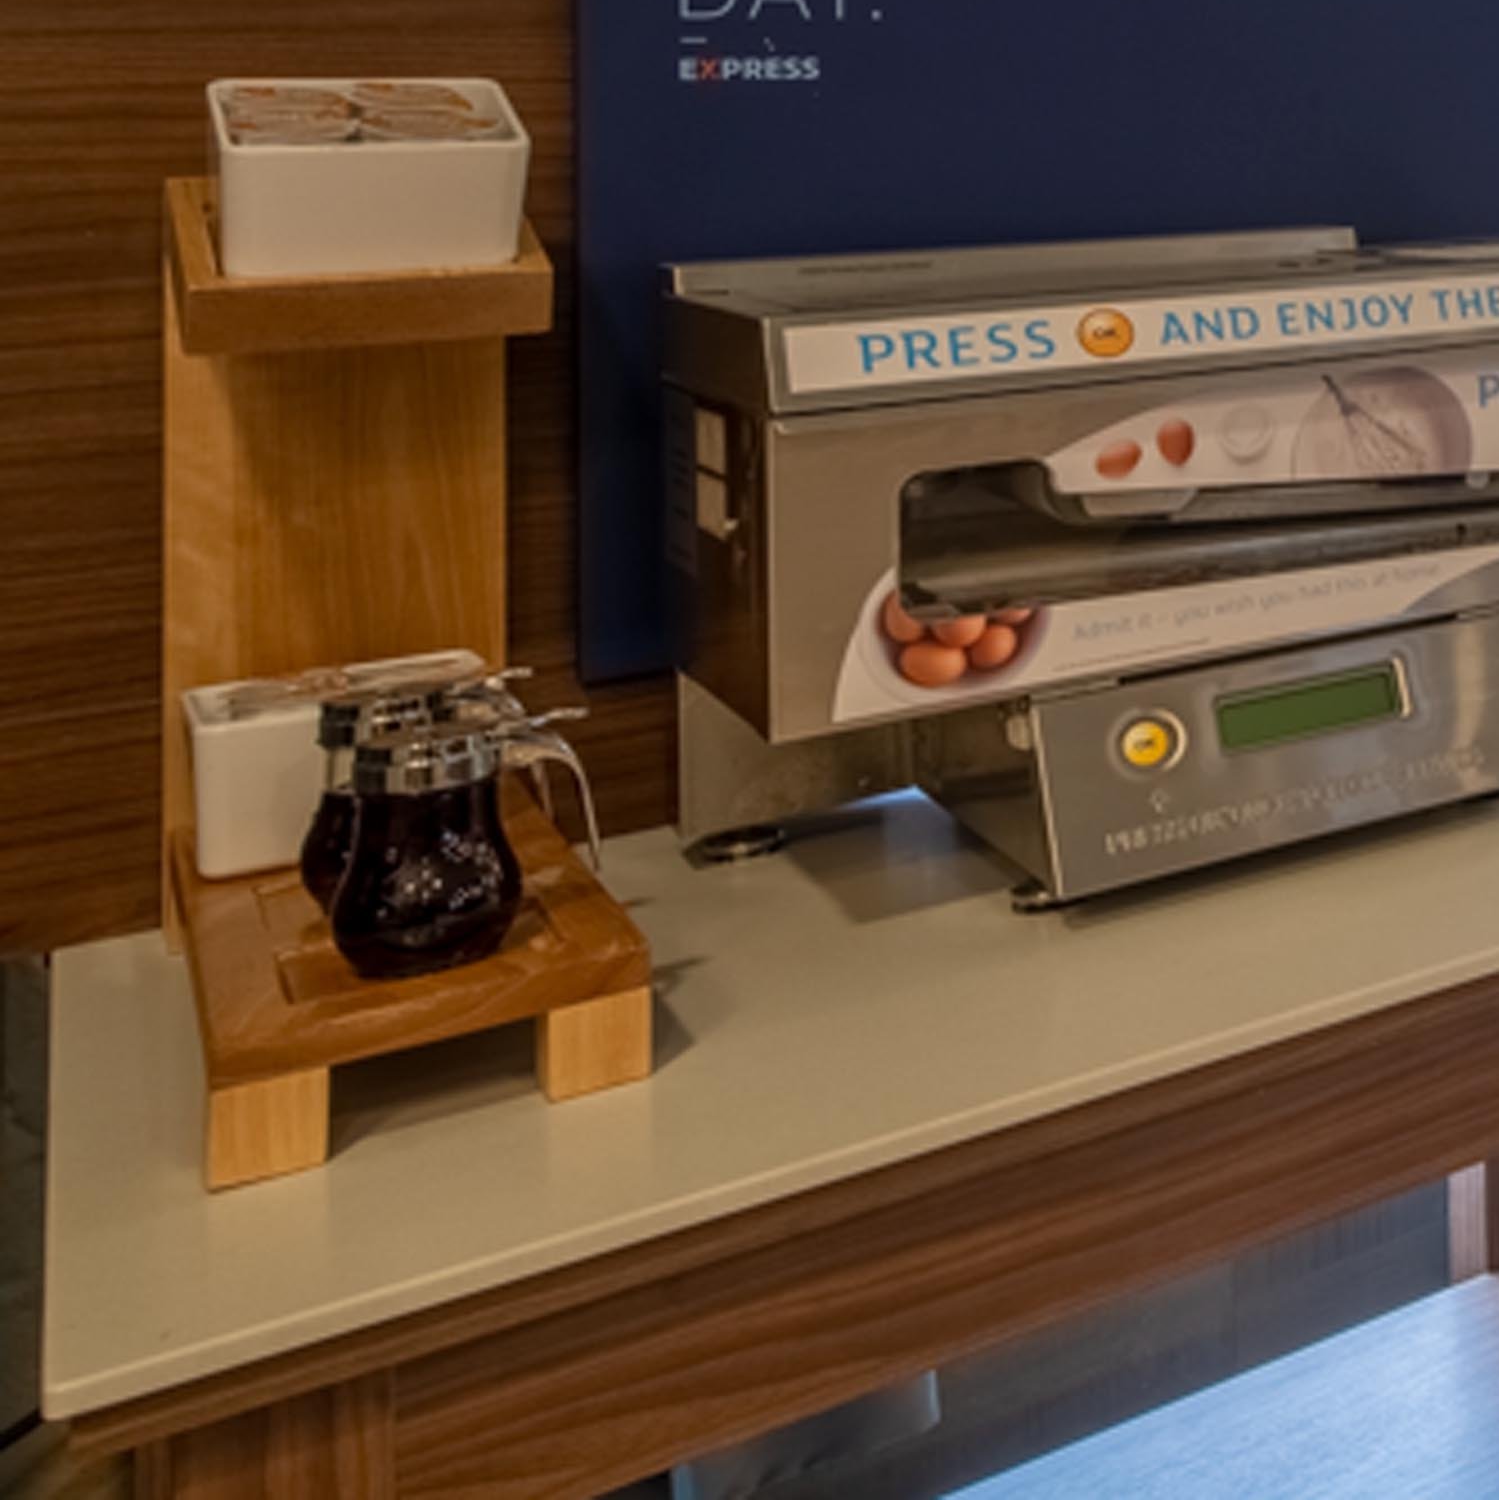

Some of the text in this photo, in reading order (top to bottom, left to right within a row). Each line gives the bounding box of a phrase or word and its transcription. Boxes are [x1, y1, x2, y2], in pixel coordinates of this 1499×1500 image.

[678, 56, 821, 81] EXPRESS
[857, 319, 1056, 373] PRESS
[1160, 304, 1261, 346] AND
[1277, 292, 1415, 337] ENJOY
[1173, 607, 1211, 629] you
